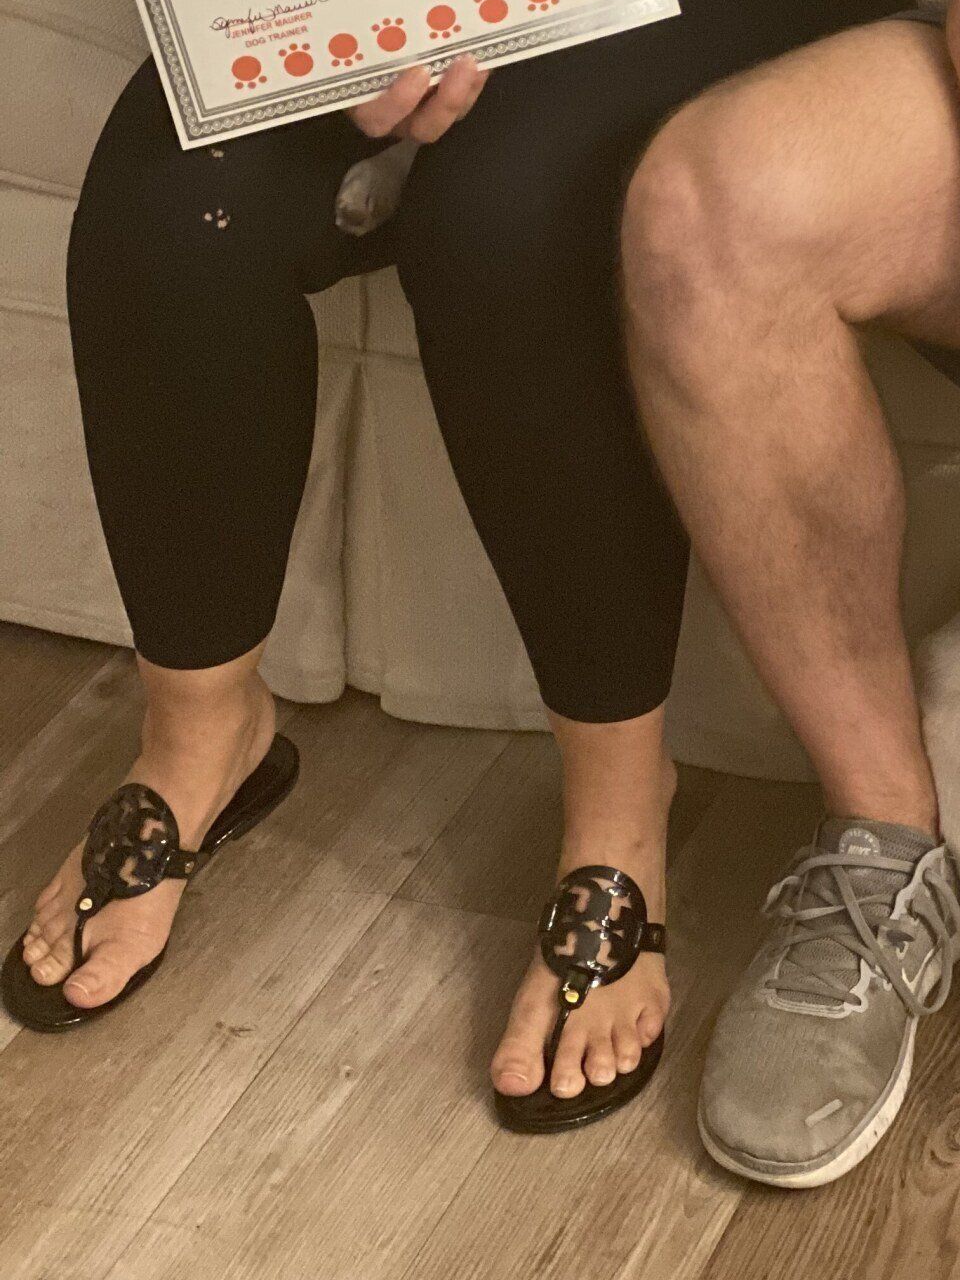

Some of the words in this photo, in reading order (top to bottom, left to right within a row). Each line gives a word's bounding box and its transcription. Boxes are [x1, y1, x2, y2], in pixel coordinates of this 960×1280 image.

[274, 11, 313, 28] MAURER
[244, 35, 268, 49] DOG
[268, 25, 309, 43] TRAINER
